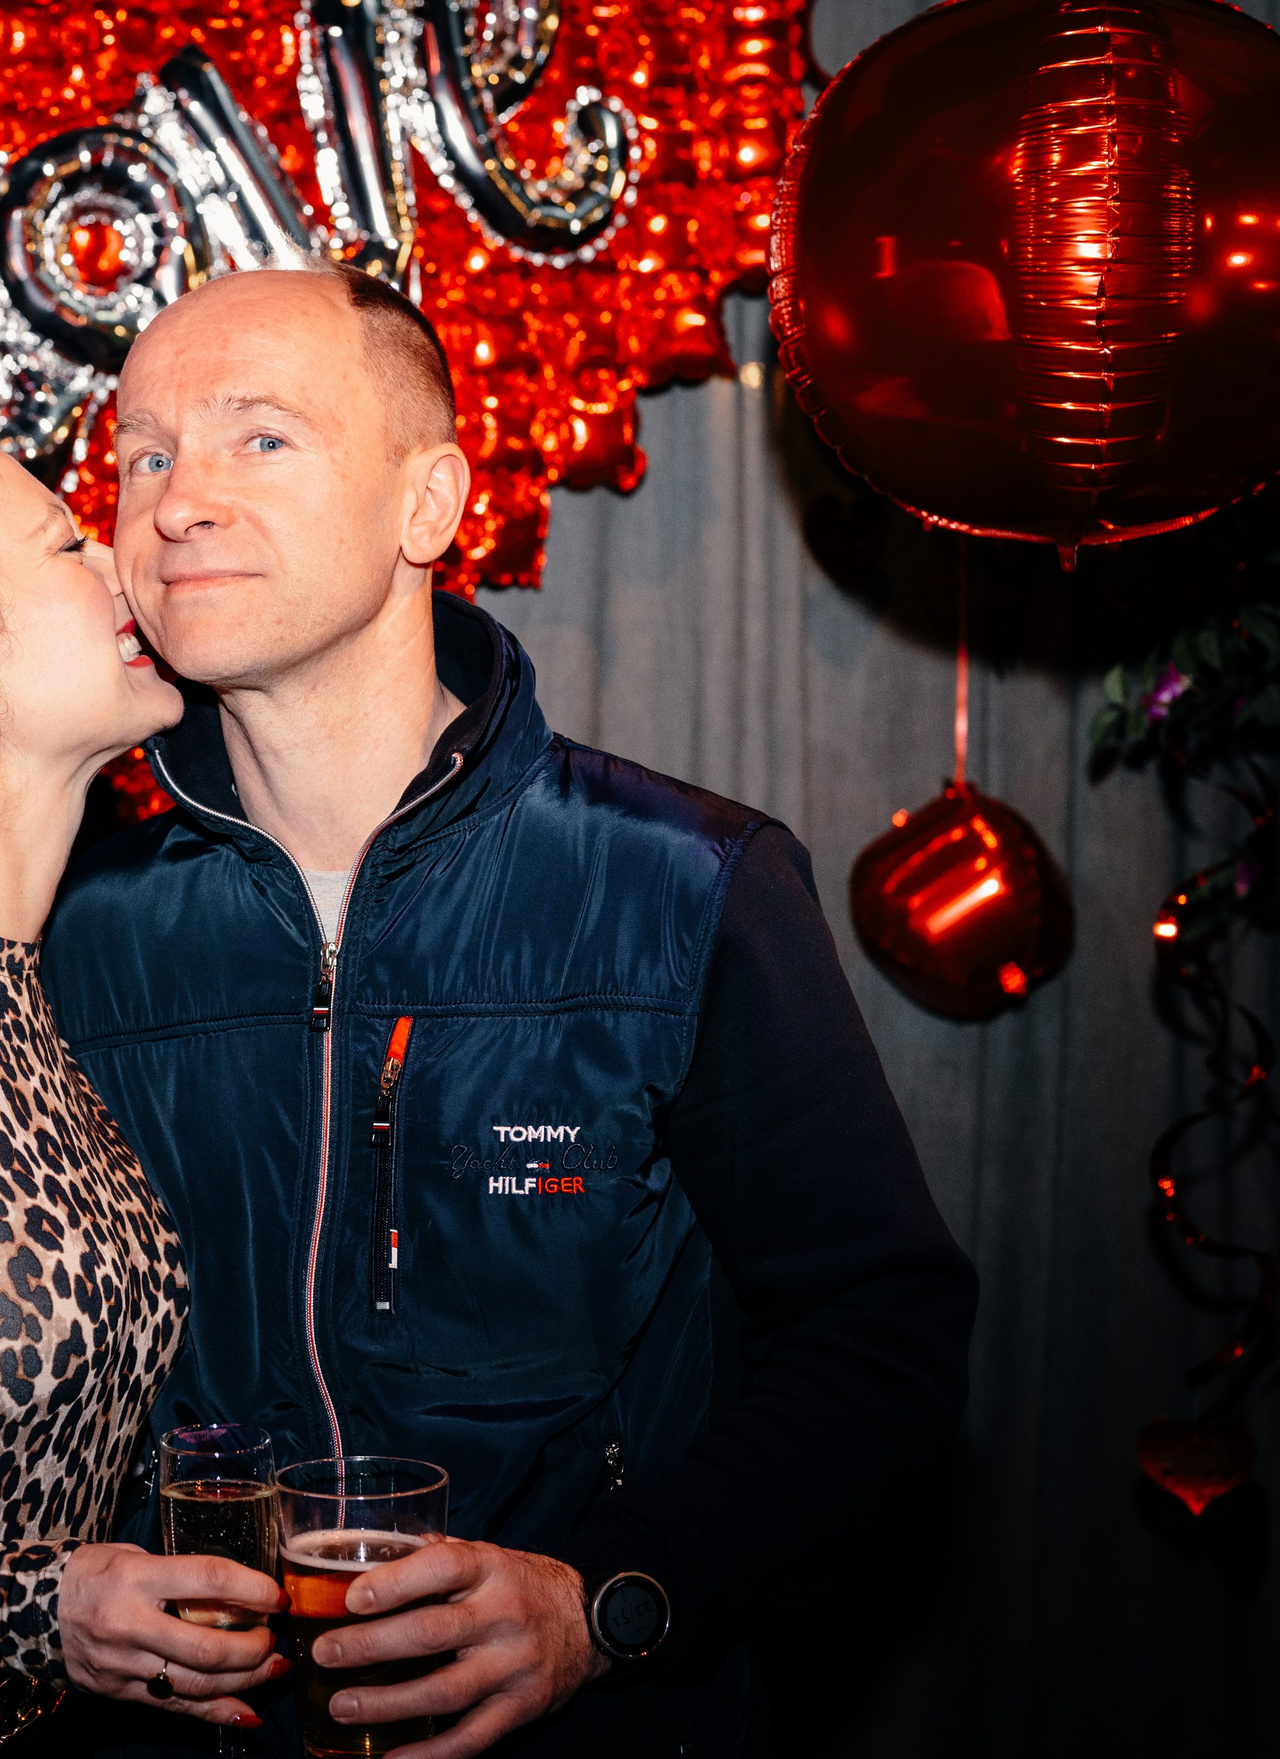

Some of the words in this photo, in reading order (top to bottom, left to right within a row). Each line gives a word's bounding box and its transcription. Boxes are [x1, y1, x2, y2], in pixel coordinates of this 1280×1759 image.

[493, 1125, 580, 1143] TOMMY
[451, 1144, 516, 1179] Yacht
[562, 1143, 618, 1170] Club
[488, 1176, 586, 1195] HILFIGER
